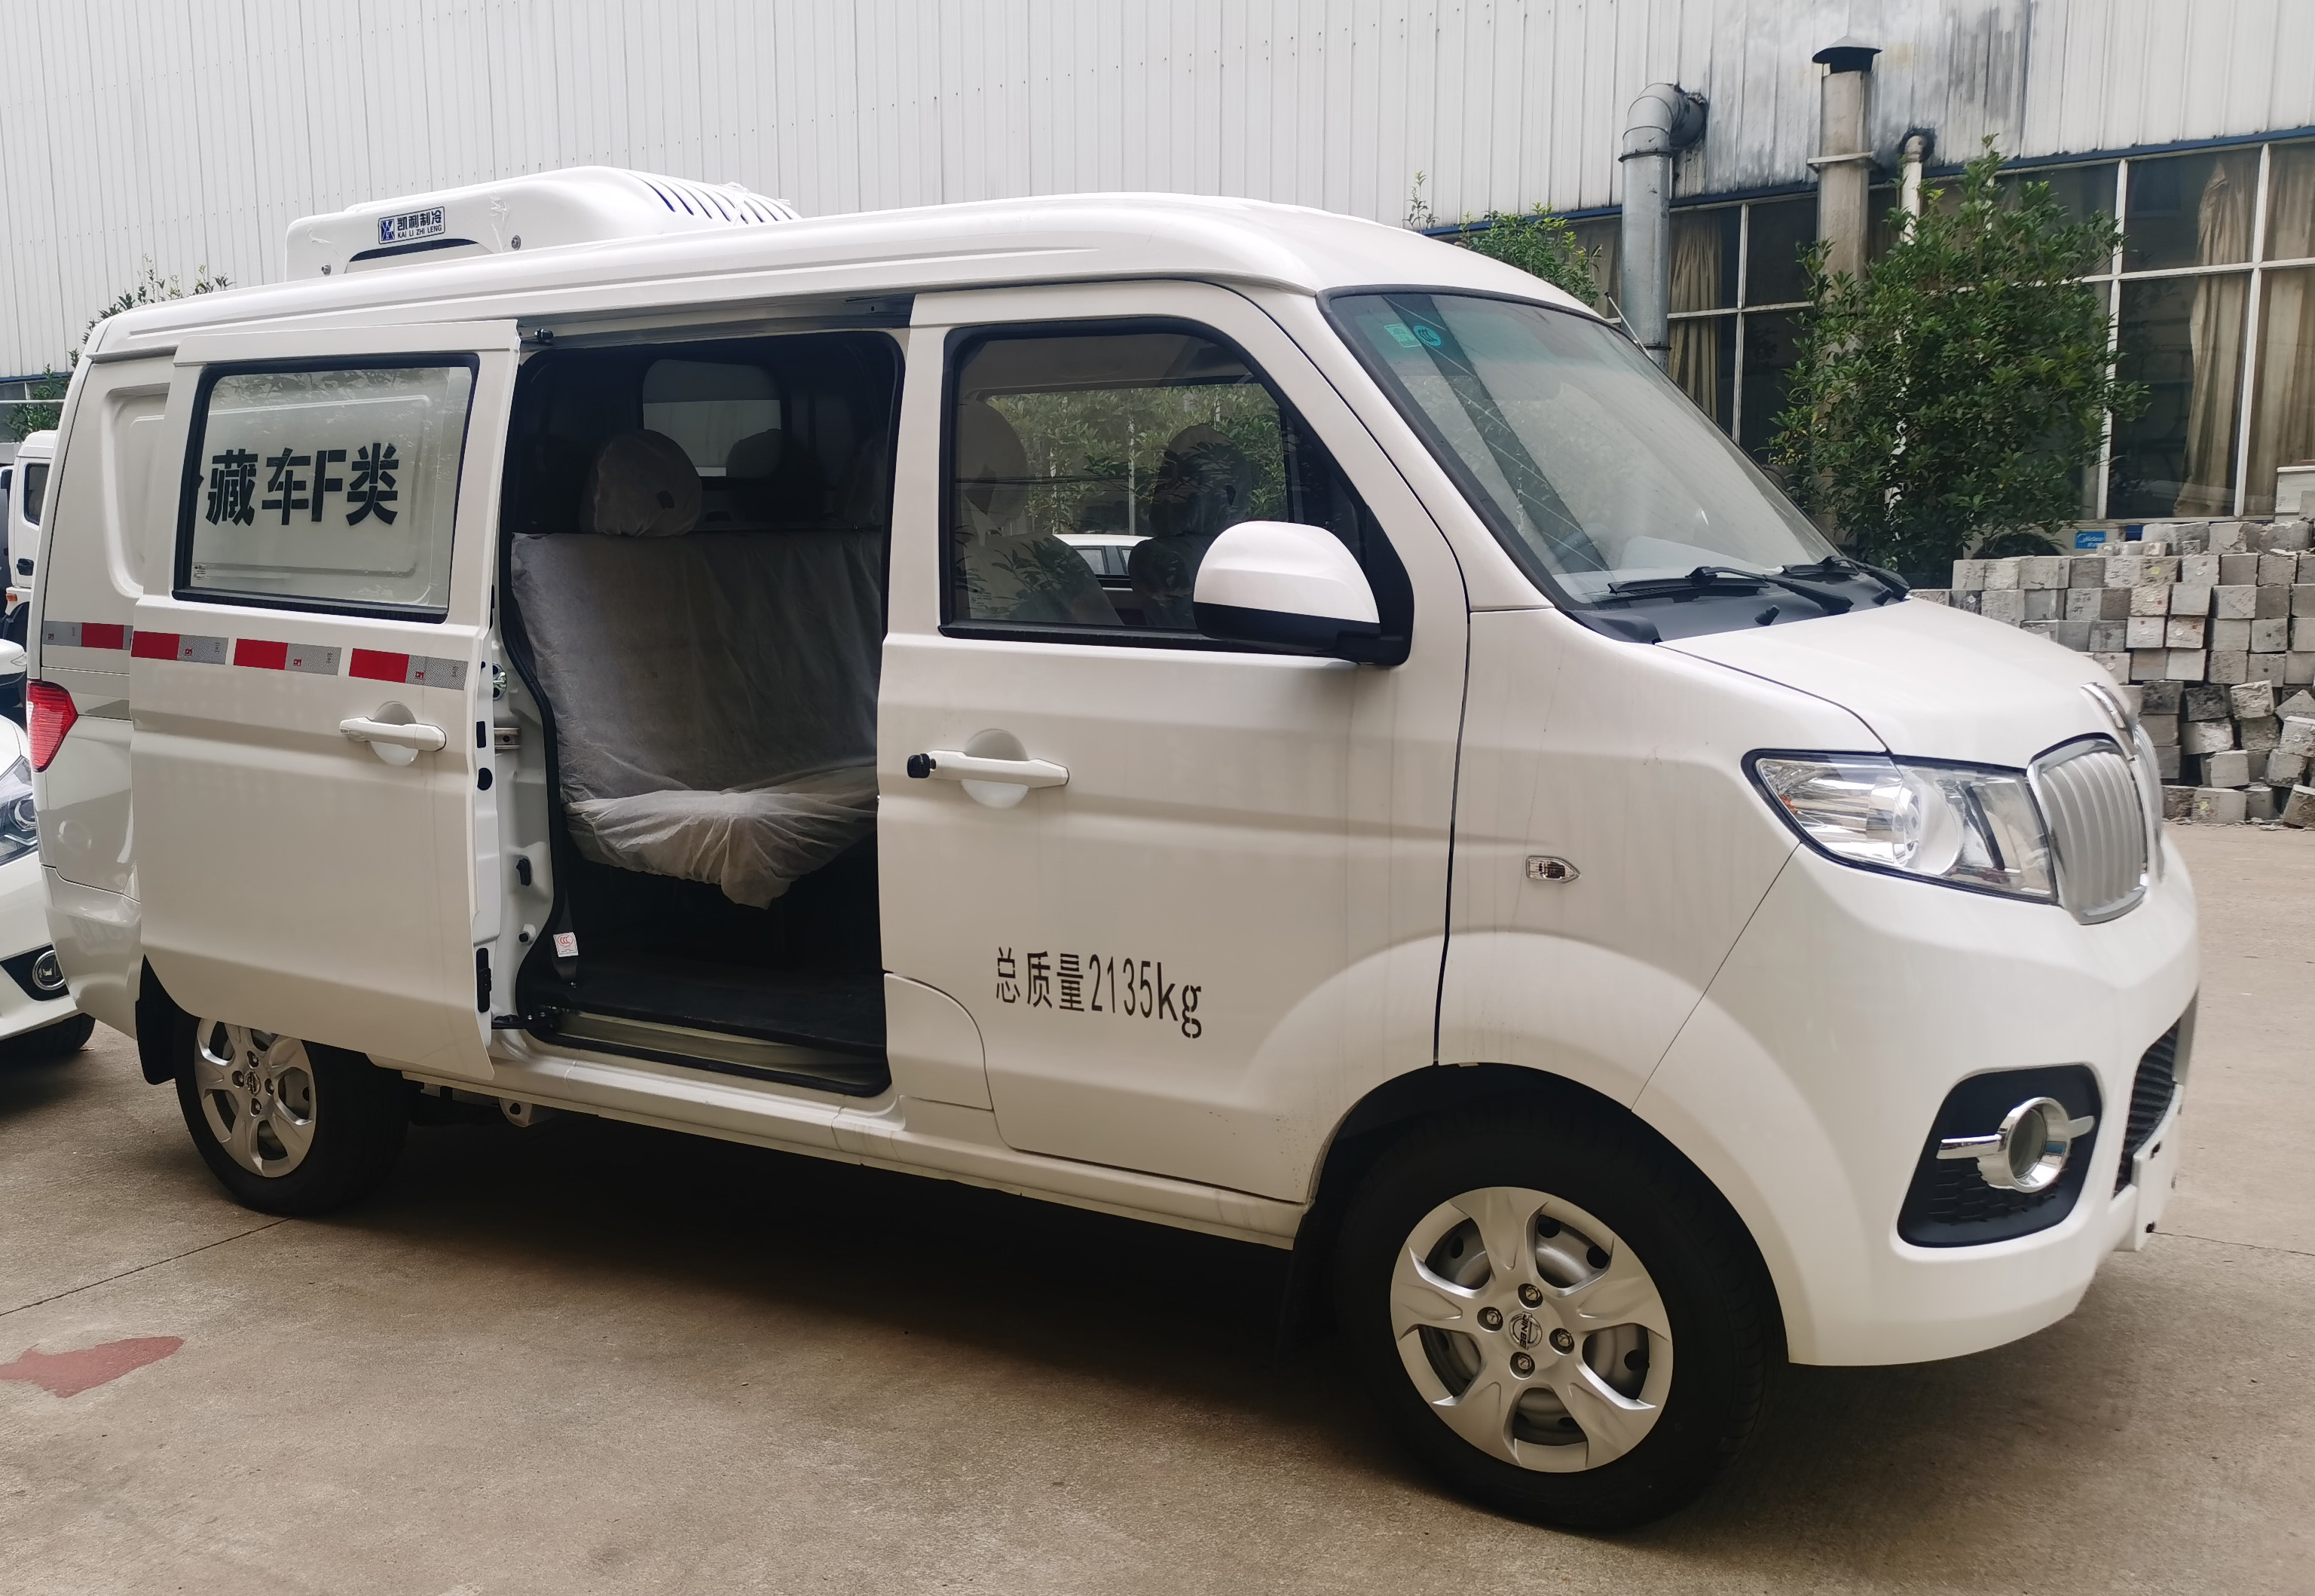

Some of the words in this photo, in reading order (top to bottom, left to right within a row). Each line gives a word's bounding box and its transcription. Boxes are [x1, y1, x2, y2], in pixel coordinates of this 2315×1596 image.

[397, 210, 442, 231] 凯利制冷
[427, 225, 442, 233] LENG
[200, 443, 399, 526] 藏车F类
[995, 946, 1201, 1038] 总质量2135kg
